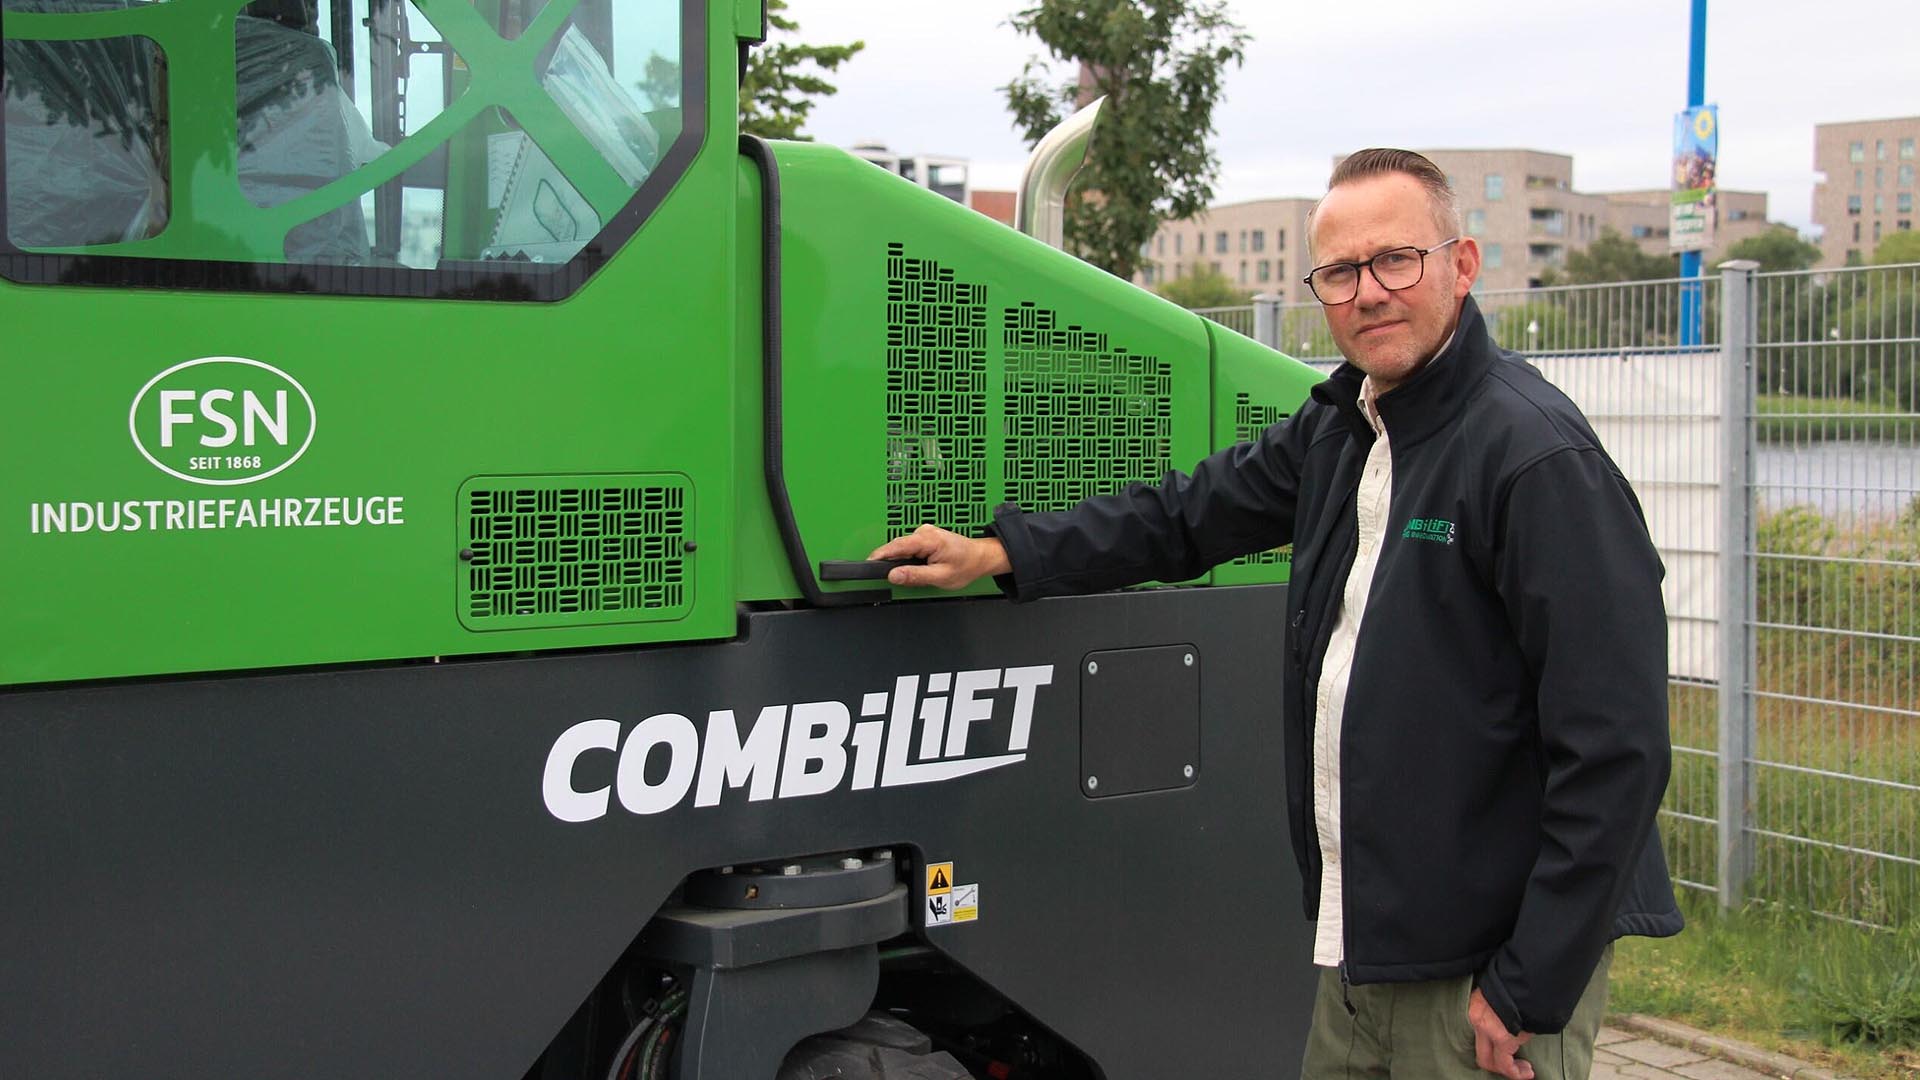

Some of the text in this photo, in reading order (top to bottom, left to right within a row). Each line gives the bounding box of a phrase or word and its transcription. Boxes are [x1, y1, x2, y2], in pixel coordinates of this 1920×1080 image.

[160, 388, 288, 448] FSN
[189, 455, 262, 470] SEIT 1868
[31, 496, 404, 534] INDUSTRIEFAHRZEUGE
